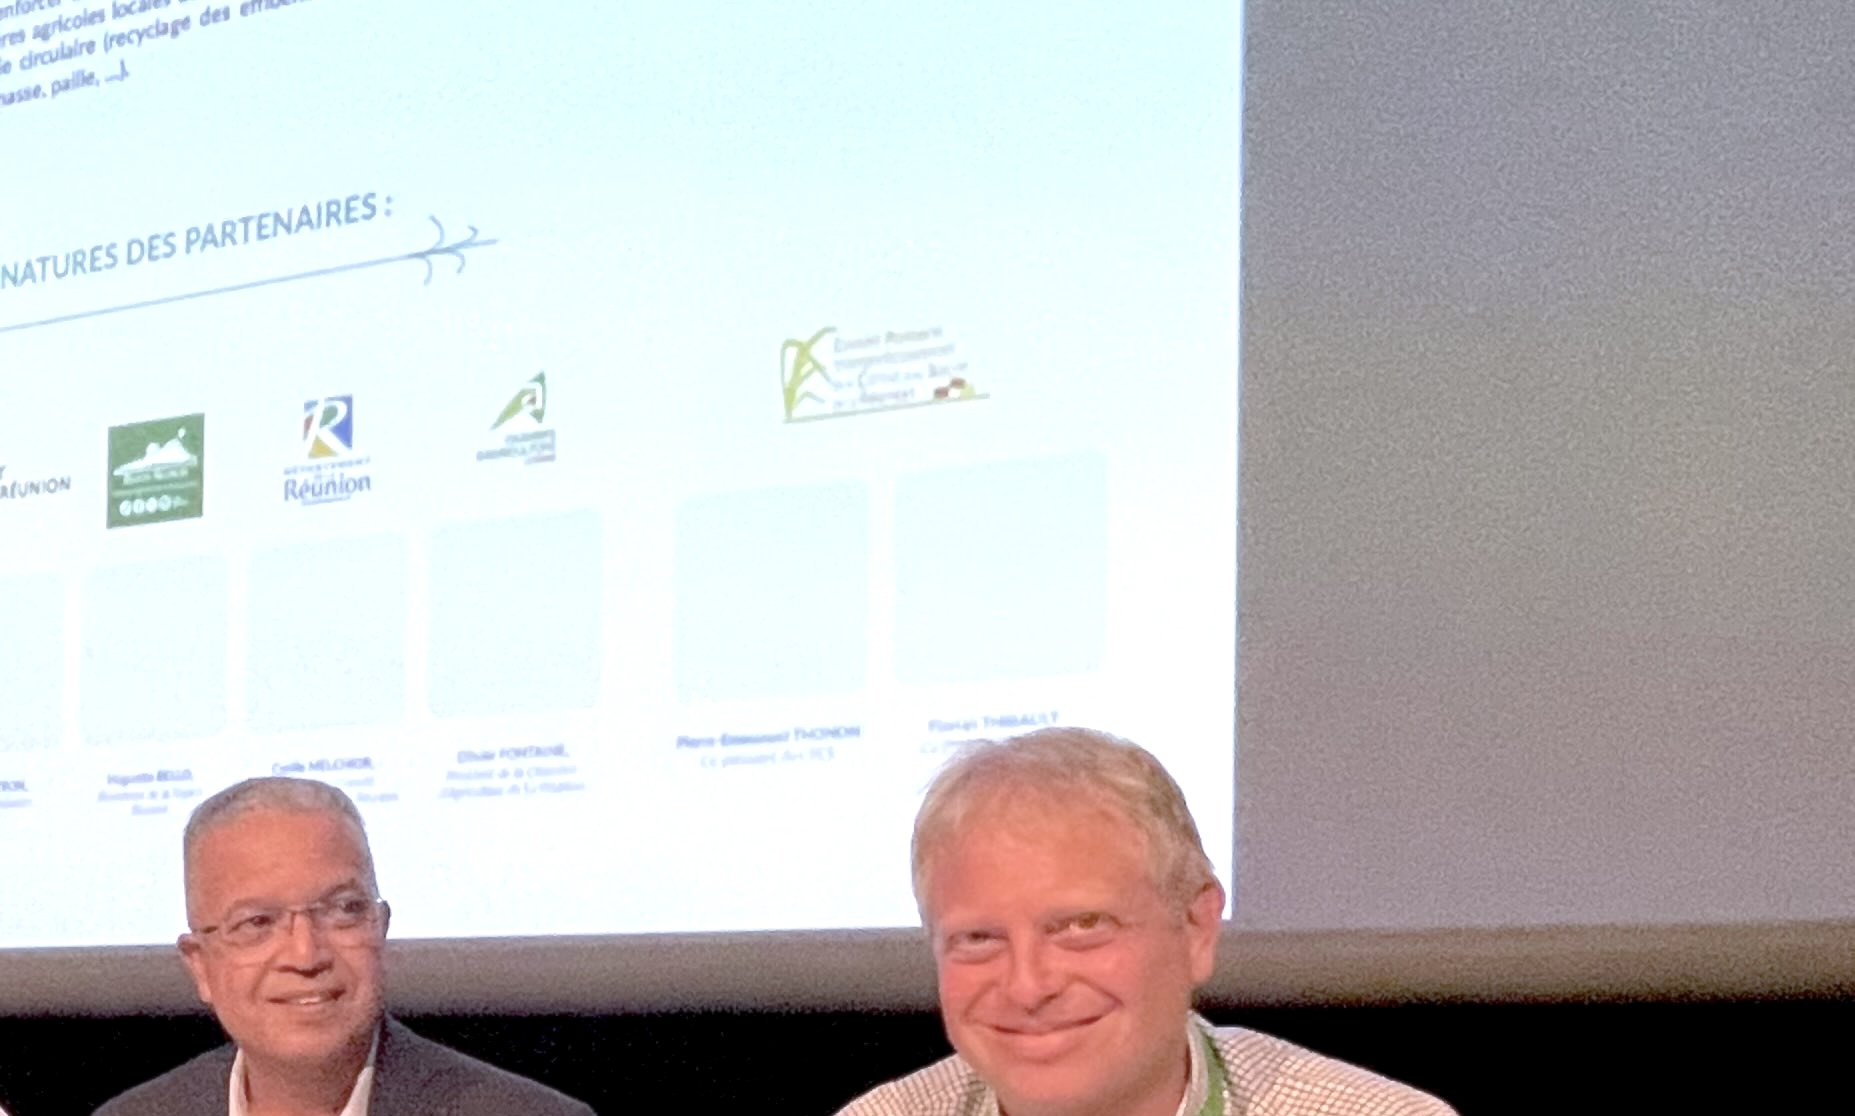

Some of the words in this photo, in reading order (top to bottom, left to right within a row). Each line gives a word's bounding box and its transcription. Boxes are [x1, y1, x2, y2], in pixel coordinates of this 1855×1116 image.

[19, 37, 96, 70] circulaire
[103, 15, 191, 54] (recyclage
[199, 5, 230, 27] des
[32, 8, 106, 40] agricoles
[125, 231, 177, 266] DES
[184, 192, 378, 255] PARTENAIRES
[284, 472, 371, 502] Réunion
